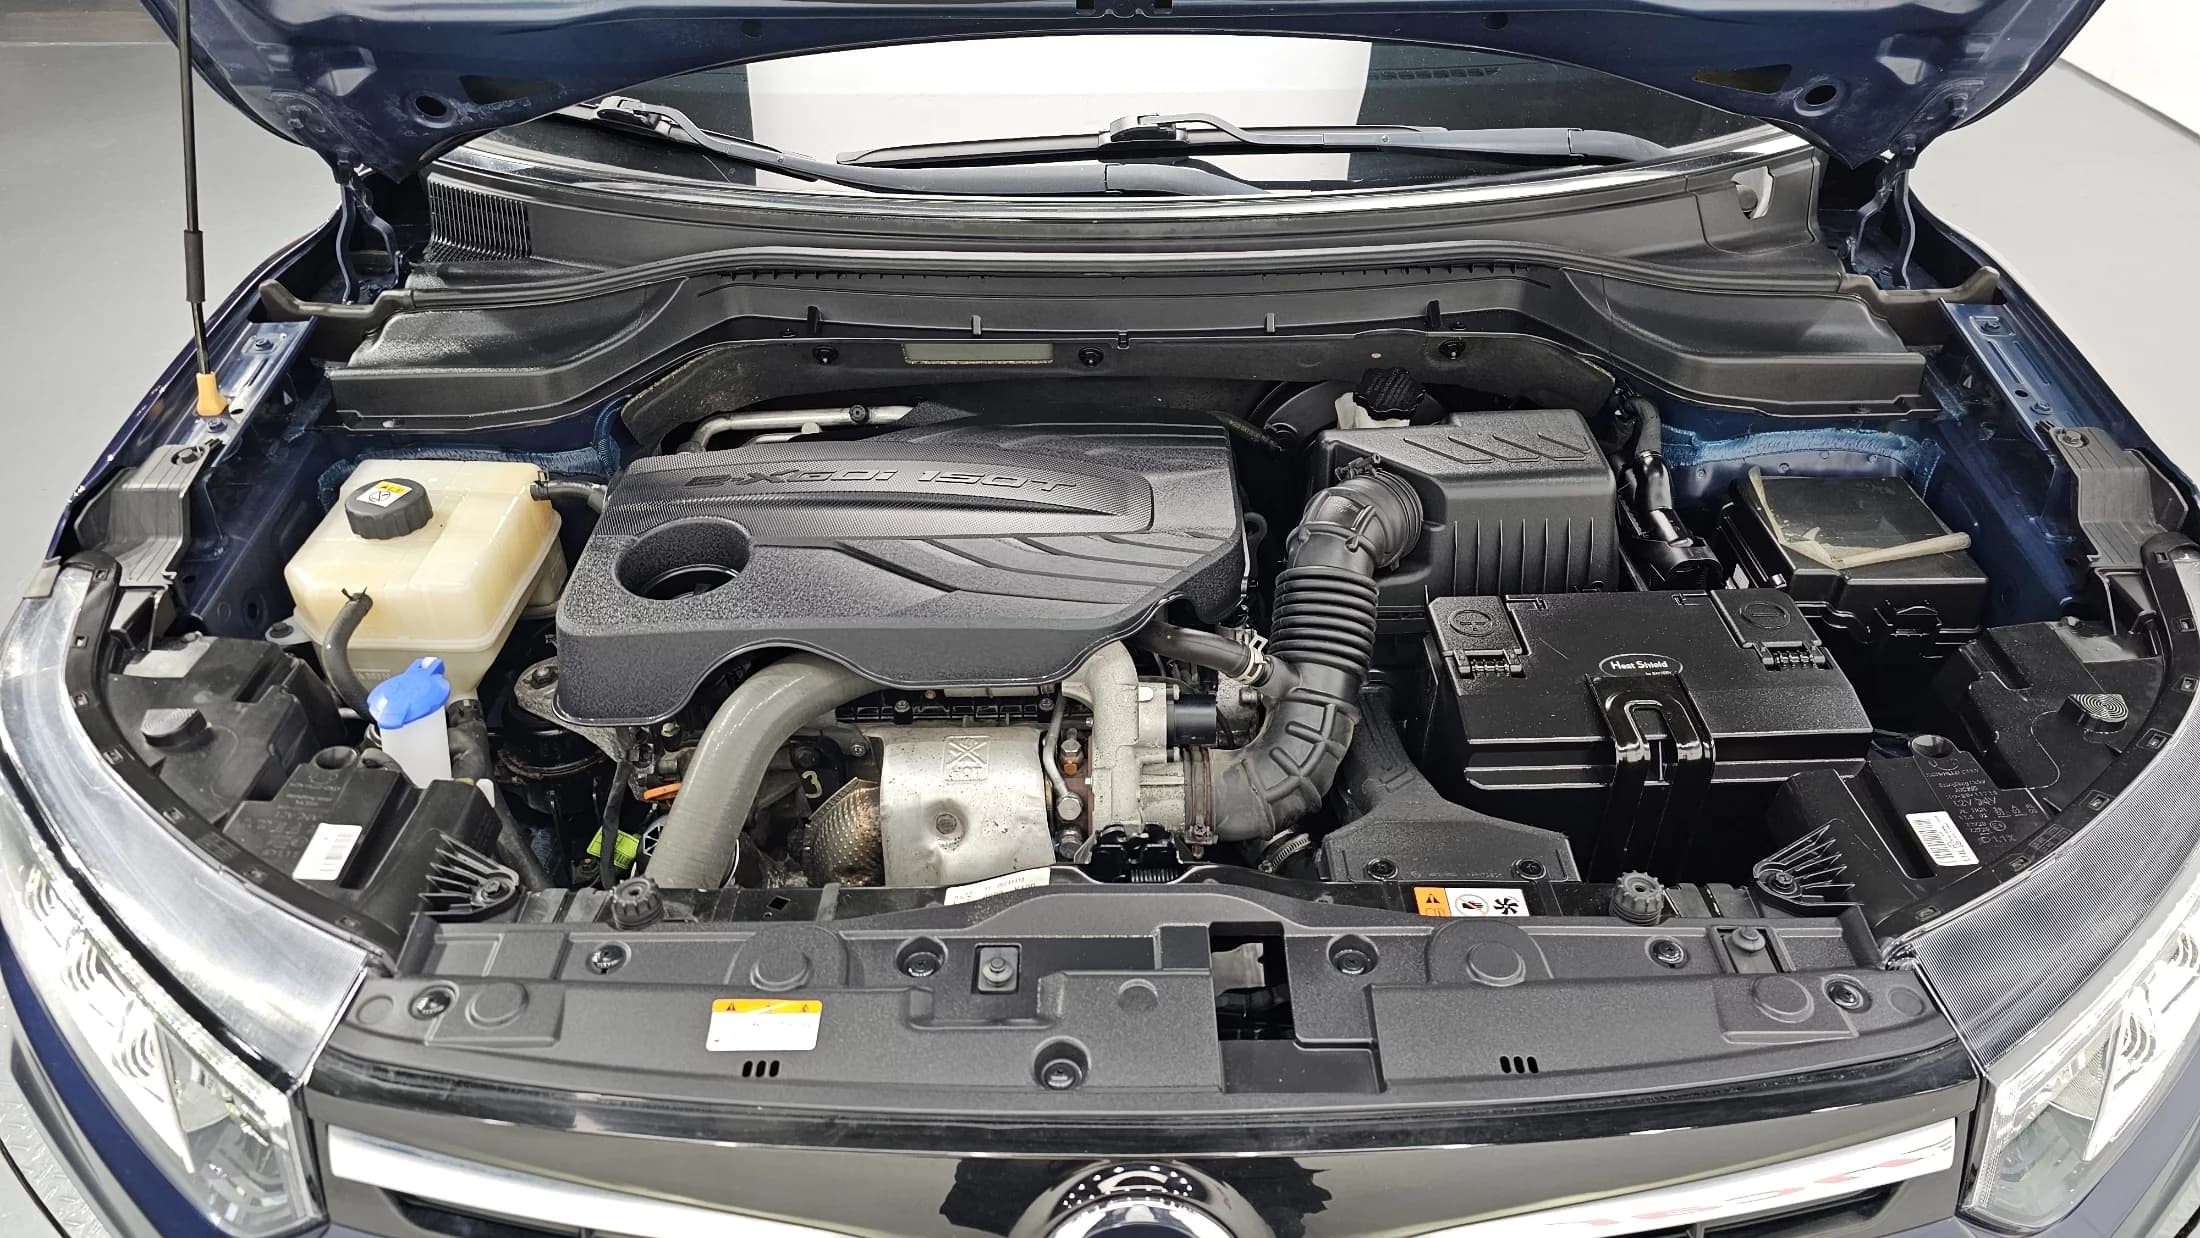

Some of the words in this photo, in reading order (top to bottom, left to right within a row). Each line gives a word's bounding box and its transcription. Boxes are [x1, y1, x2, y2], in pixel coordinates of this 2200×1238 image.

[918, 469, 1077, 492] 150T
[1610, 660, 1636, 670] Heat
[1636, 660, 1668, 669] Shield
[801, 770, 823, 799] 3
